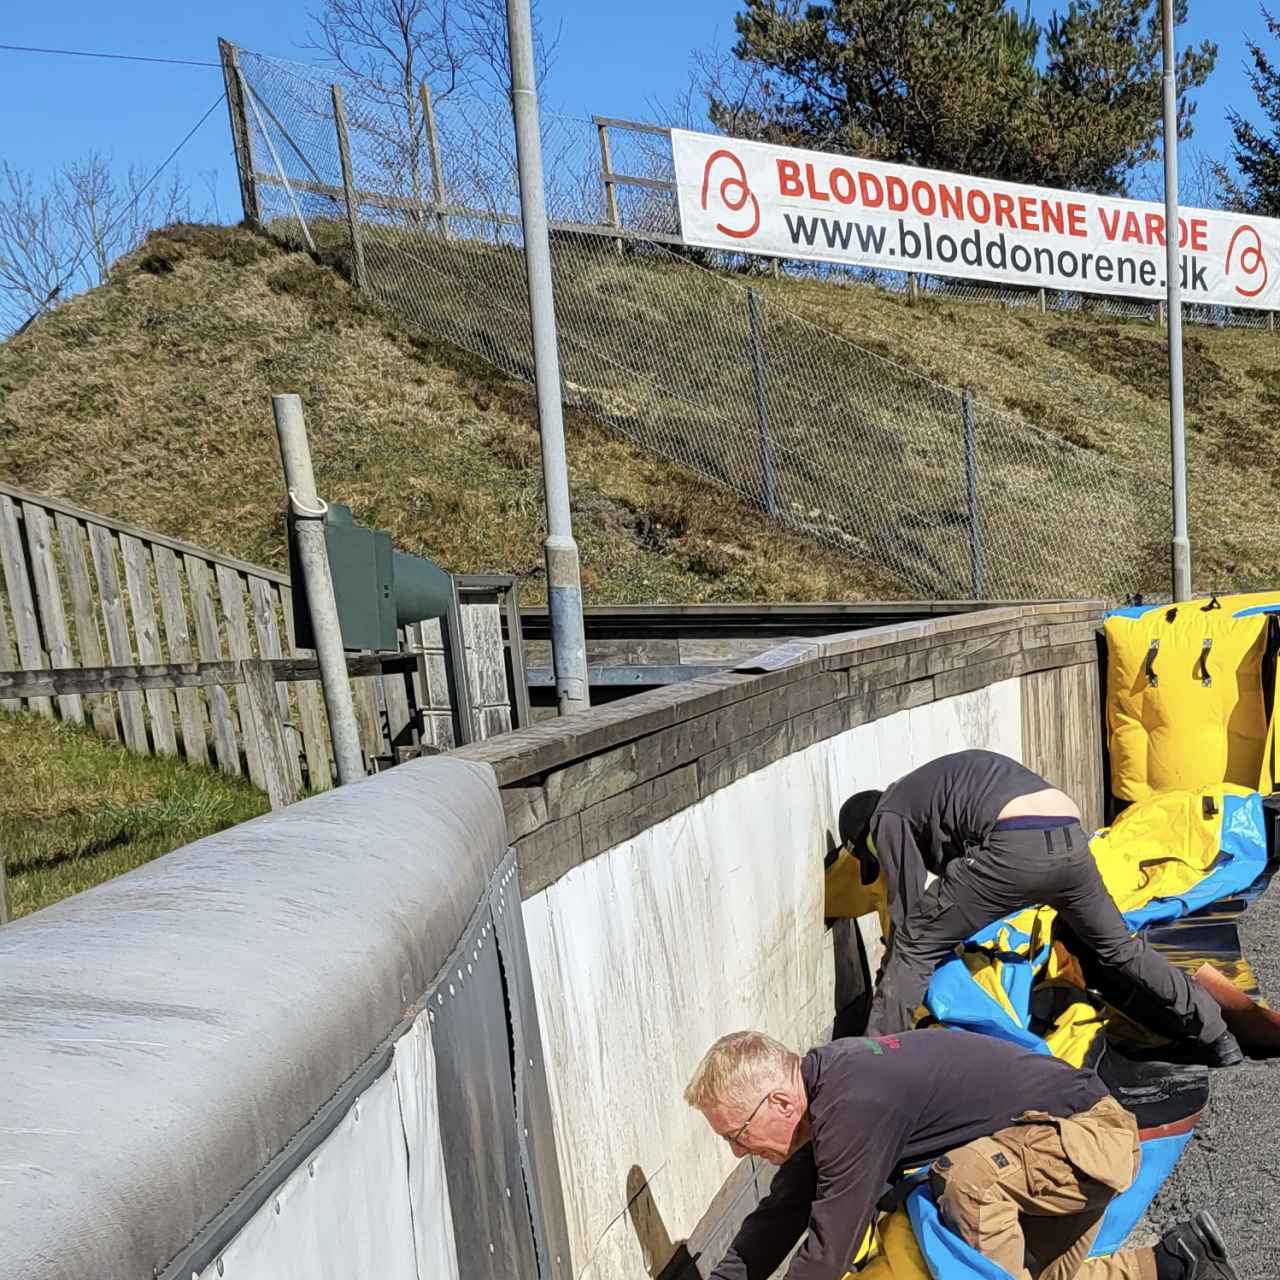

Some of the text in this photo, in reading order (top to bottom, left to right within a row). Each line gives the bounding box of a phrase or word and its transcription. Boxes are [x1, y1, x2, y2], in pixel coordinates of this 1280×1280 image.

[775, 158, 1209, 252] BLODDONORENE VARDE
[783, 213, 1209, 292] www.bloddonorene.dk
